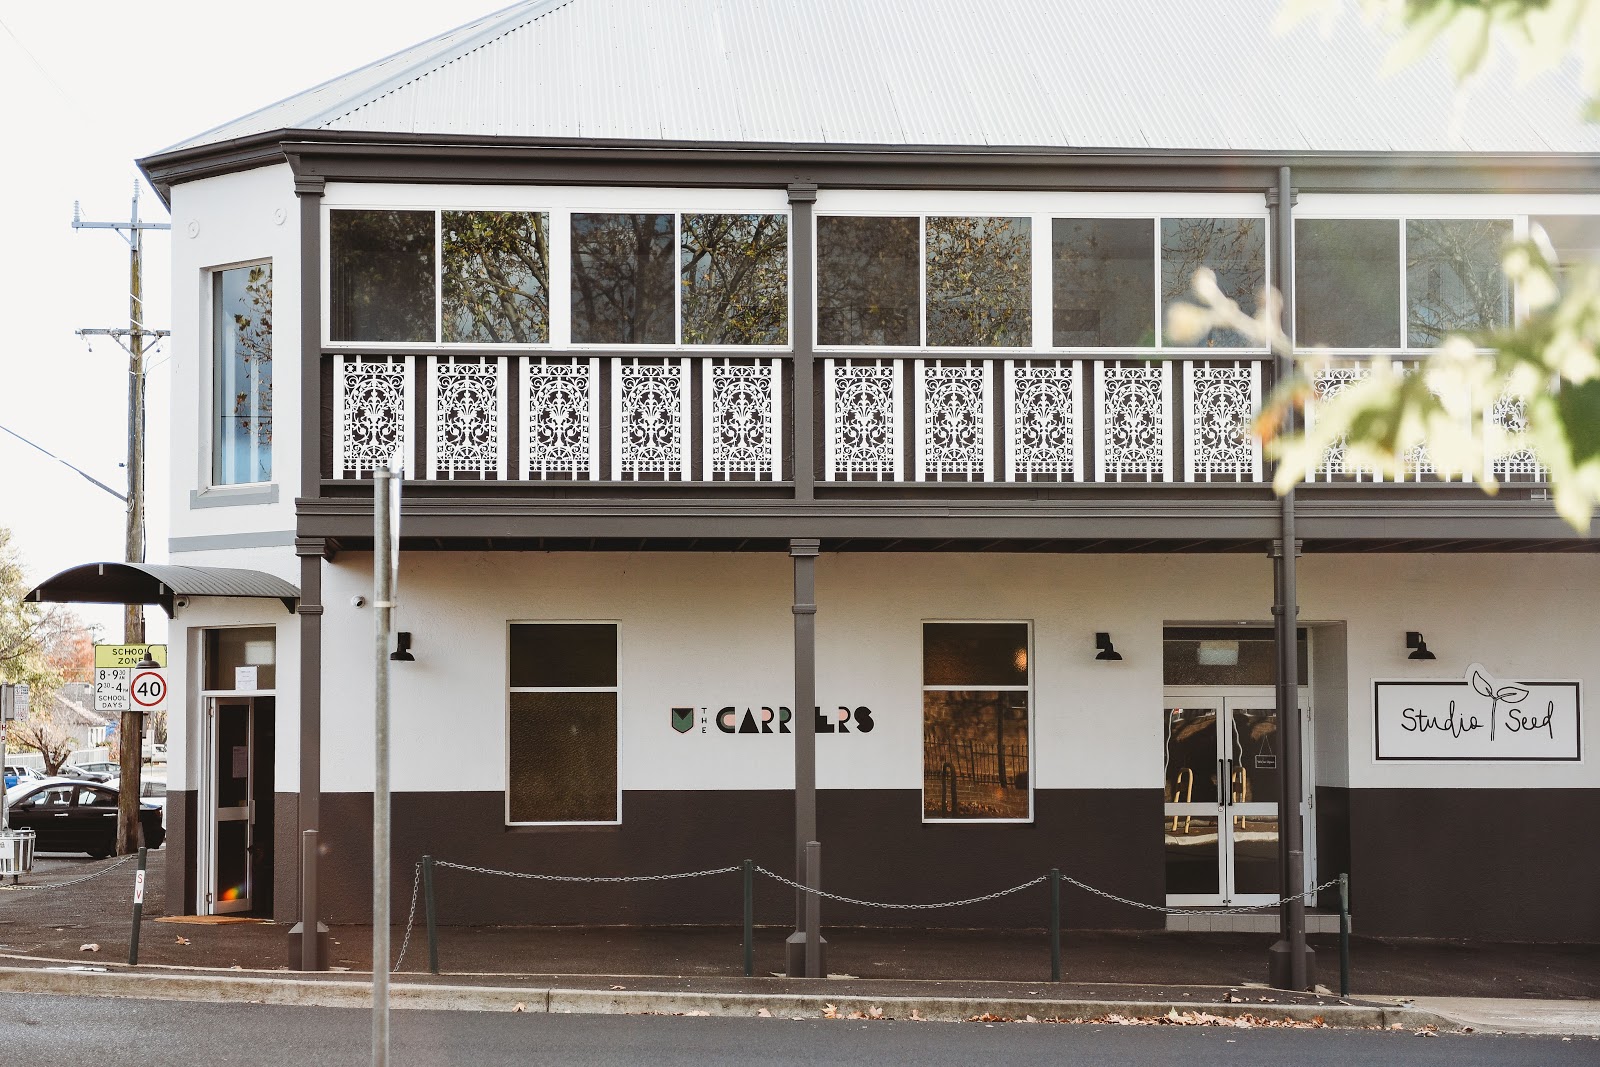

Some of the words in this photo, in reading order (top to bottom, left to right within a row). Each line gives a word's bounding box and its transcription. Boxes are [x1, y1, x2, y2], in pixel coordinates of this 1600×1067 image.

[137, 682, 160, 696] 40
[715, 706, 875, 733] CARRERS
[1401, 699, 1484, 738] Studio
[1505, 700, 1554, 739] Seed
